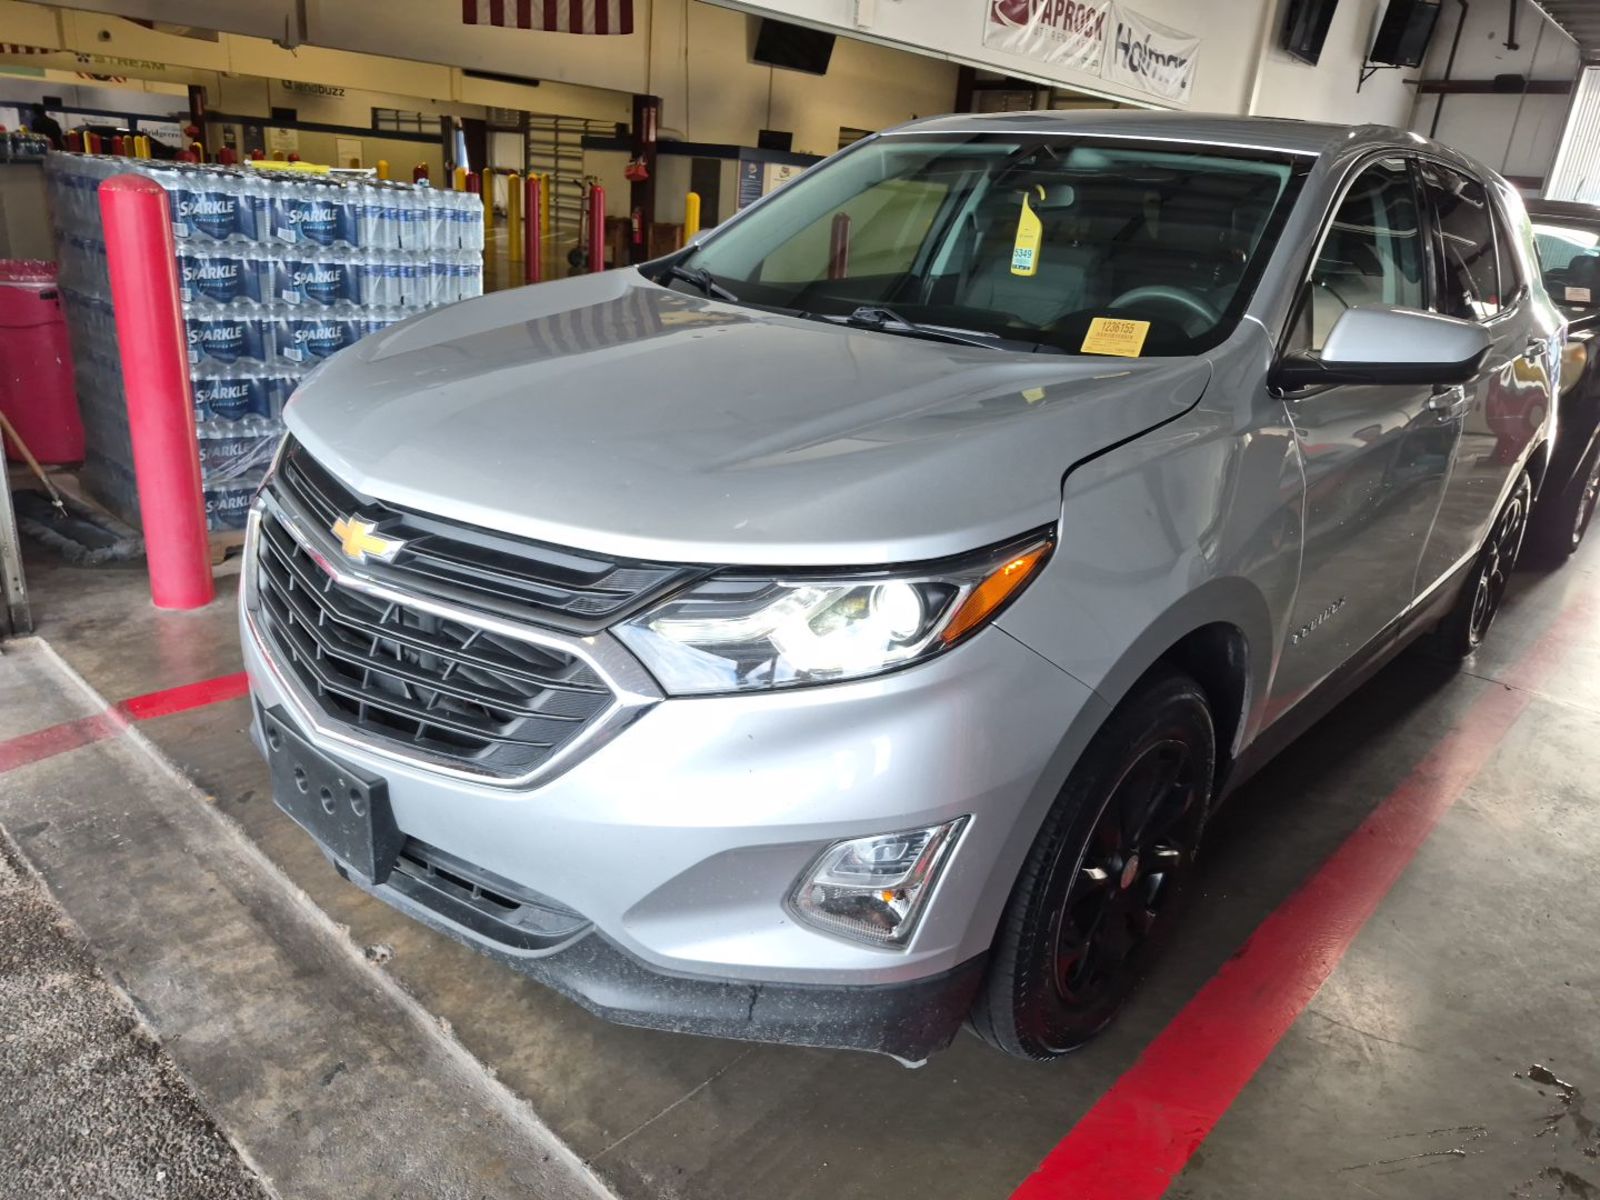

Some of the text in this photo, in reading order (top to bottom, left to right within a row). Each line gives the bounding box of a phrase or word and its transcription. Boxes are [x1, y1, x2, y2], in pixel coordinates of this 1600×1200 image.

[180, 200, 235, 216] SPARKLE
[288, 208, 338, 224] SPARKLE
[183, 264, 237, 281] SPARKLE
[293, 269, 341, 286] SPARKLE
[189, 326, 242, 344] SPARKLE
[294, 325, 343, 344] SPARKLE
[195, 384, 249, 404] SPARKLE
